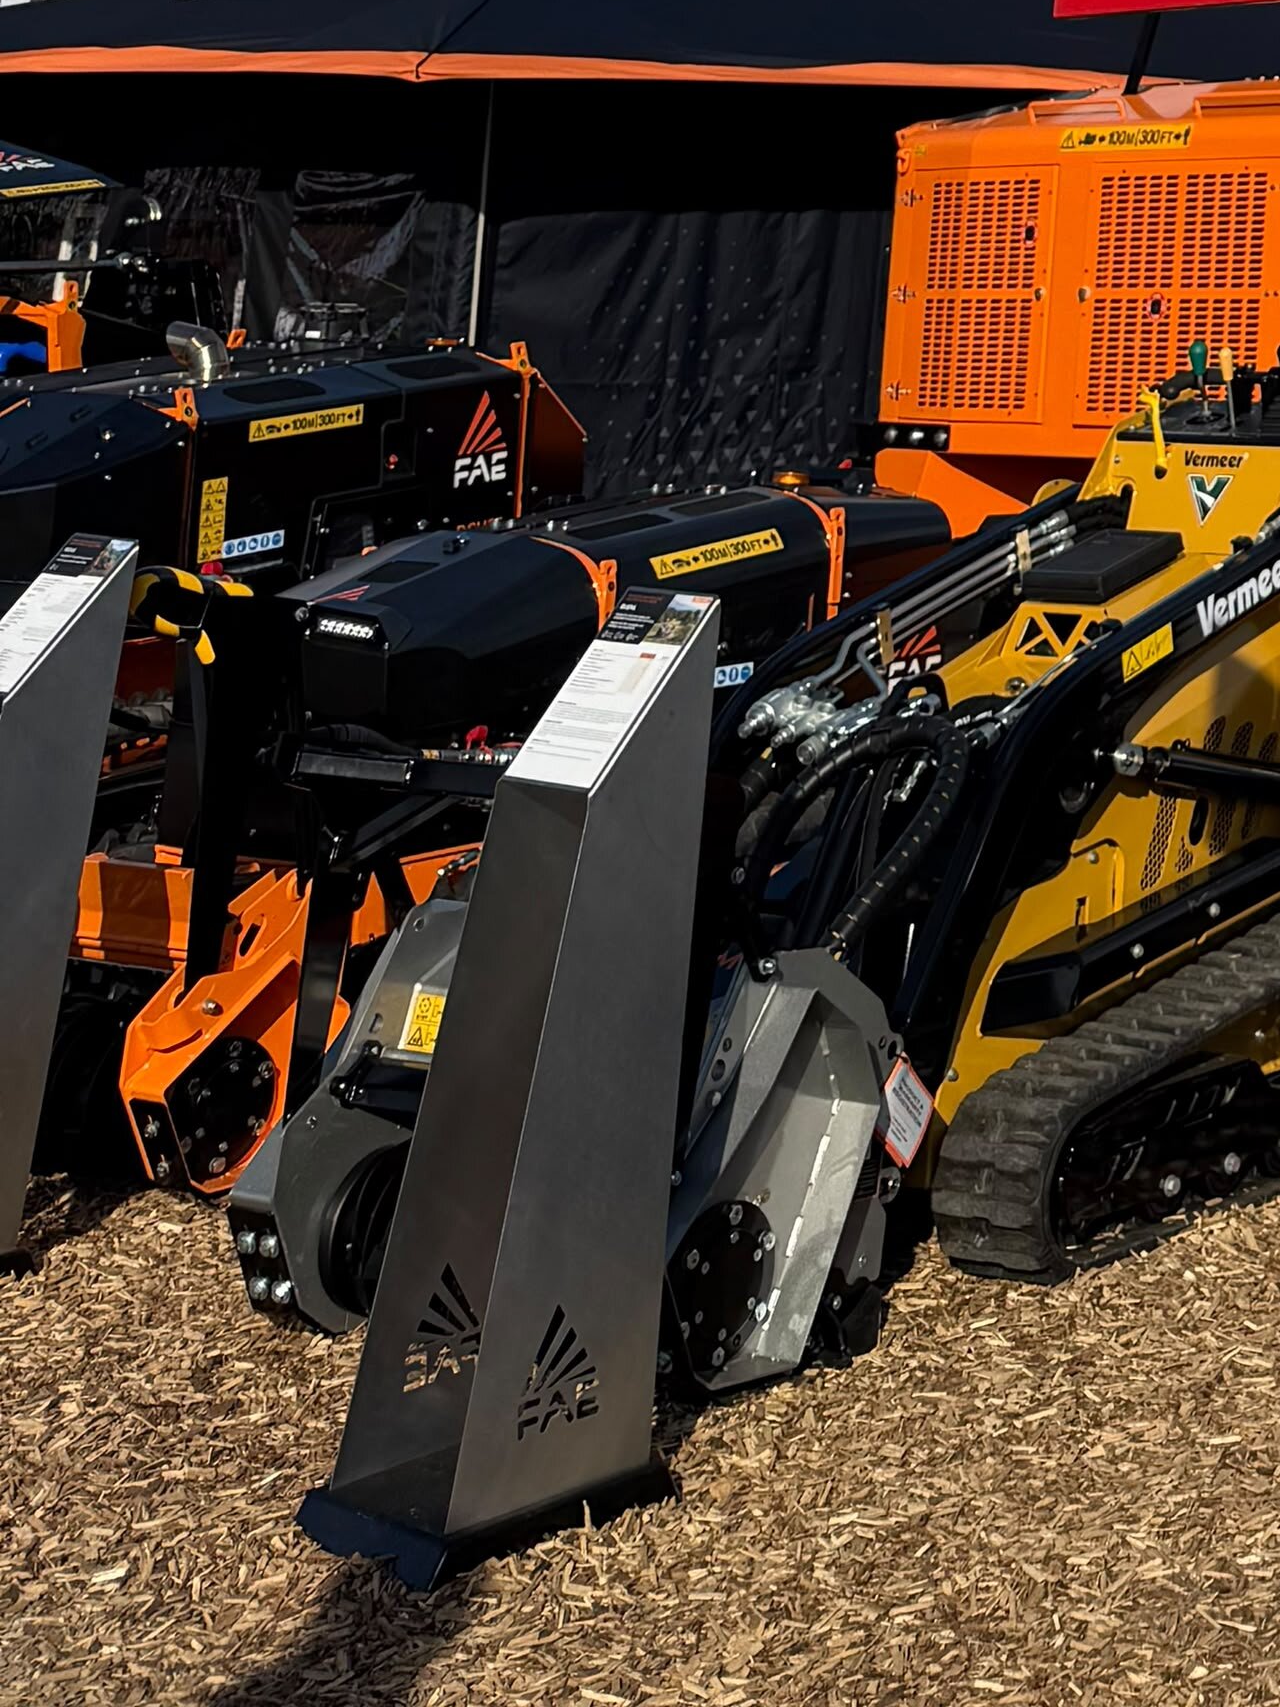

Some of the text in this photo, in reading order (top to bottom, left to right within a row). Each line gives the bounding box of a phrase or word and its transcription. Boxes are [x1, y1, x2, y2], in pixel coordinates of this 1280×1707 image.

[453, 451, 508, 488] FAE
[1184, 450, 1244, 468] Vermeer
[518, 1378, 600, 1441] FAE
